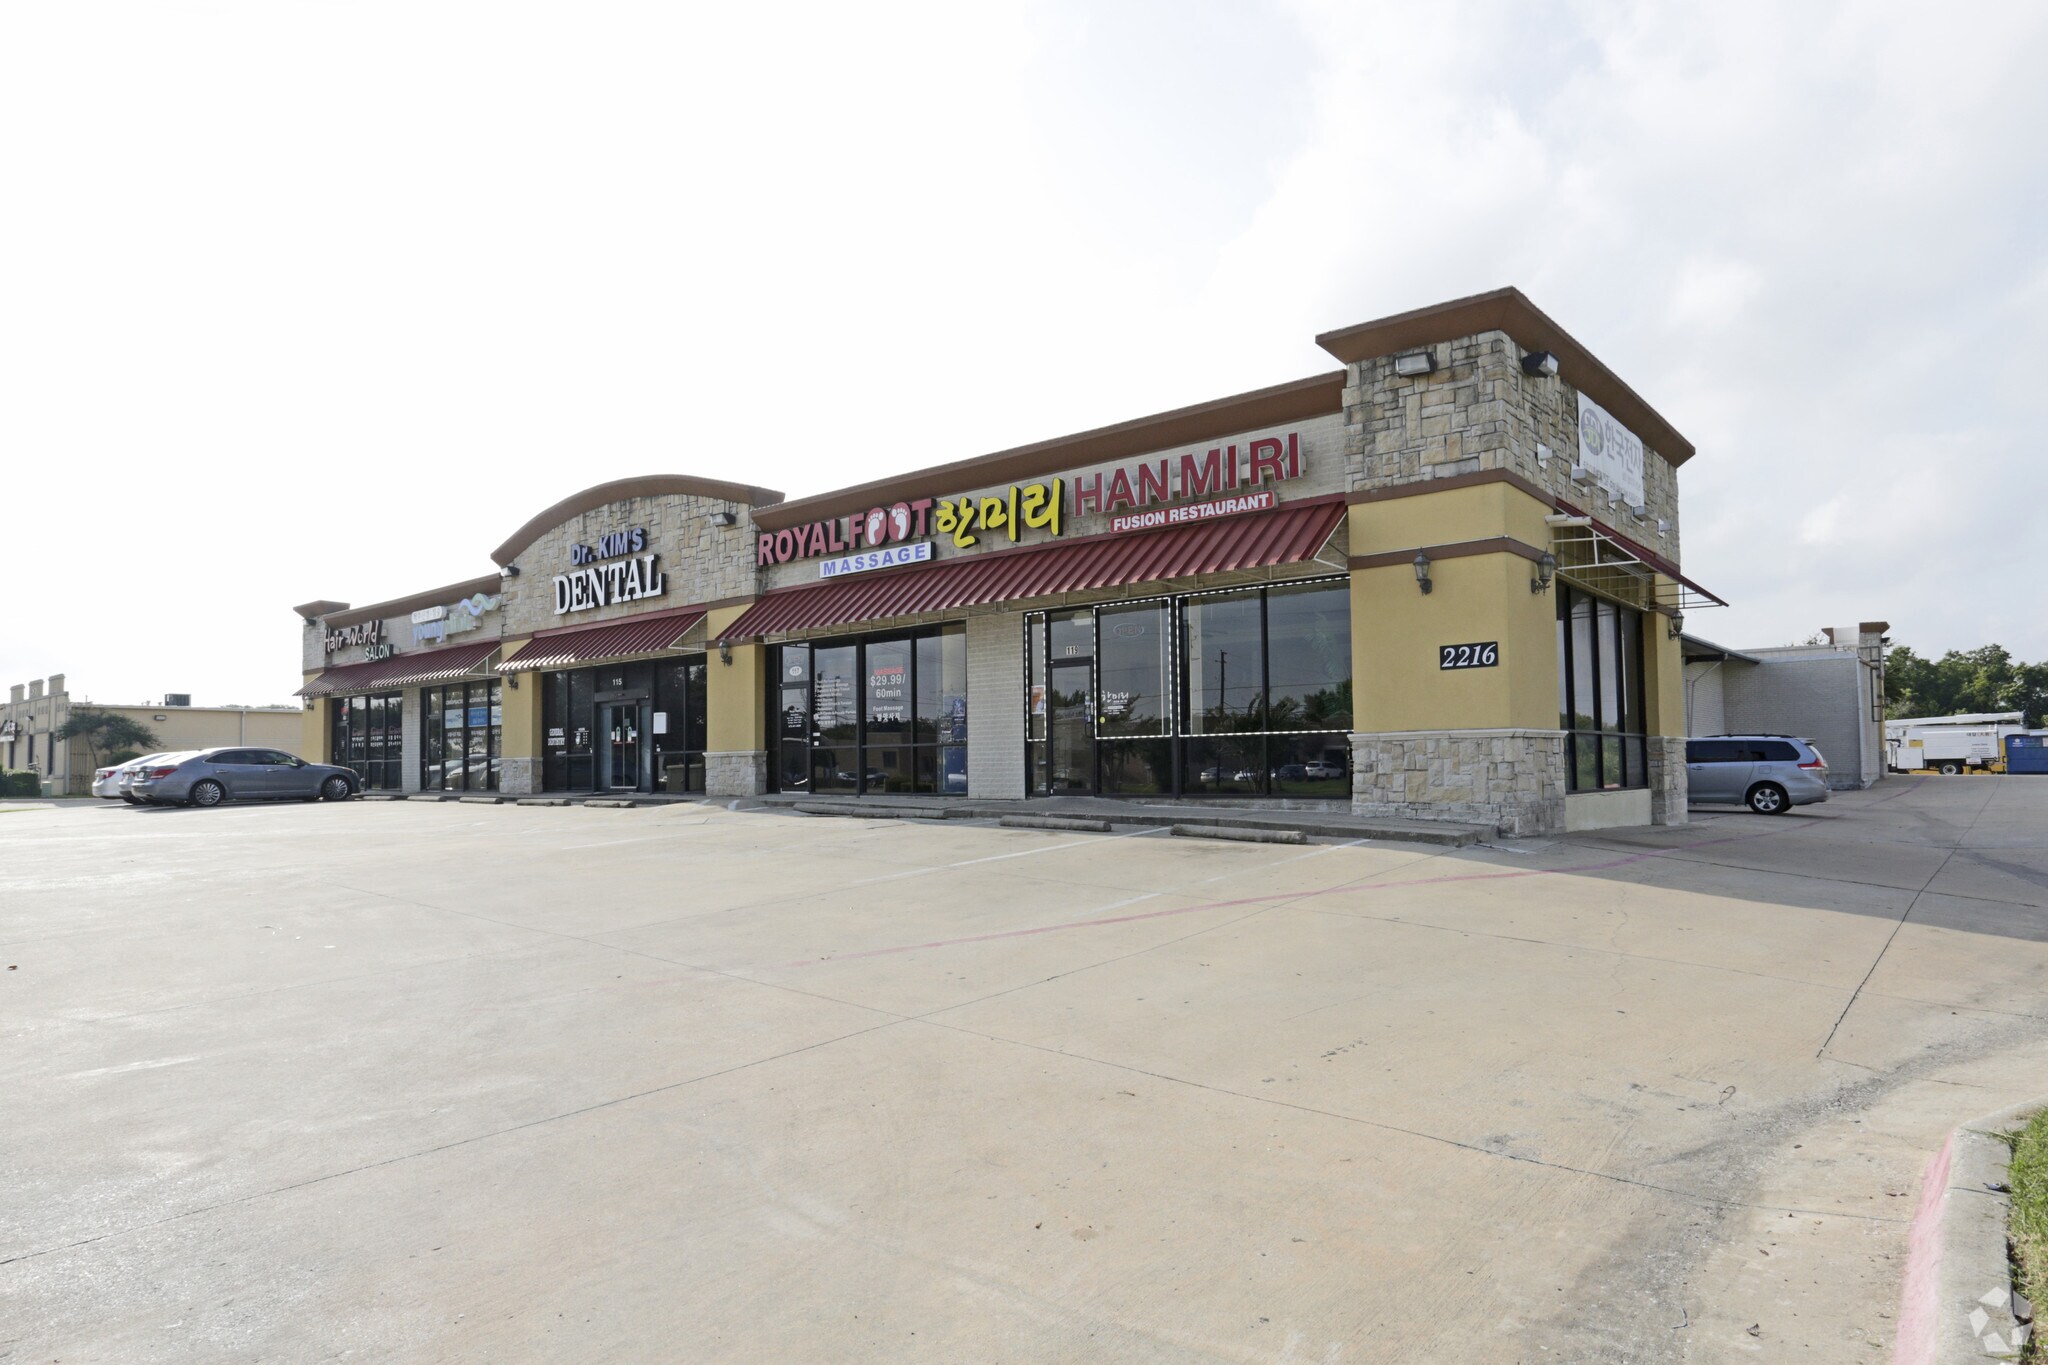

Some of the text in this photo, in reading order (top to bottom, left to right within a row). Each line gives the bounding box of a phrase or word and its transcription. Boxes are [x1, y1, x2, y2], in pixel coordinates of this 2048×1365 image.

[1604, 419, 1641, 474] 한국전자
[1074, 432, 1300, 517] HAN MI RI
[935, 477, 1062, 548] 한미리
[1113, 493, 1269, 531] FUSION RESTAURANT
[570, 528, 643, 566] Dr. KIM'S
[823, 544, 926, 576] MASSAGE
[552, 554, 662, 616] DENTAL
[324, 628, 343, 653] Hair
[365, 645, 390, 661] SALON
[1066, 646, 1079, 655] 119
[1441, 643, 1497, 668] 2216
[612, 678, 622, 686] 115
[870, 674, 905, 687] $29.99/
[876, 688, 901, 698] 60min
